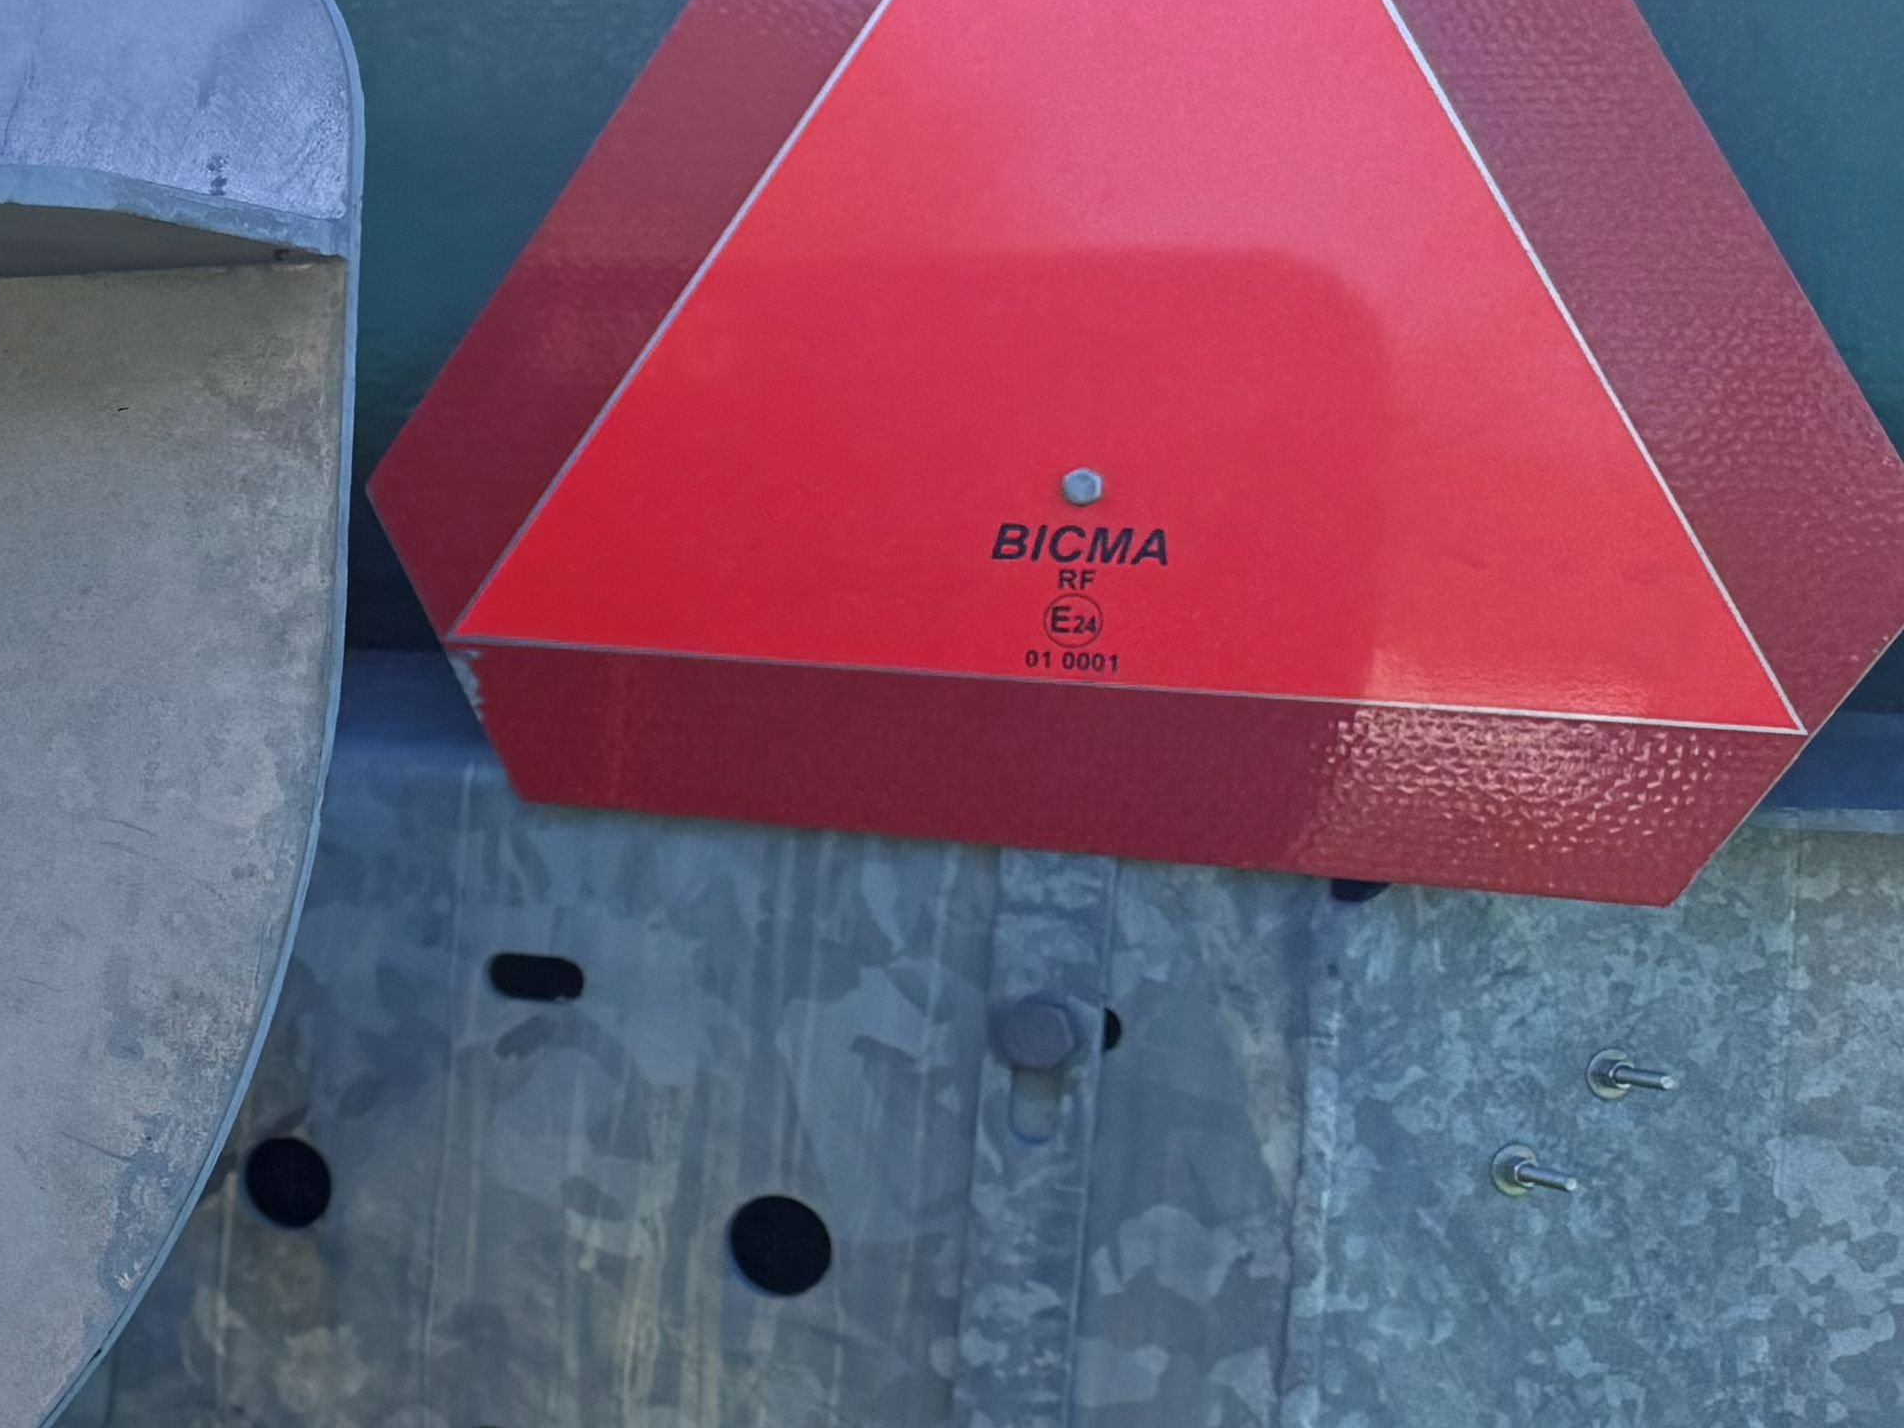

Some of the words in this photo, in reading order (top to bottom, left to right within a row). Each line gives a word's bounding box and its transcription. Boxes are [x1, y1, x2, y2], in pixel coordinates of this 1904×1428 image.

[991, 523, 1168, 566] BICMA
[1056, 569, 1097, 590] RF
[1025, 650, 1051, 668] 01
[1062, 651, 1118, 673] 0001
